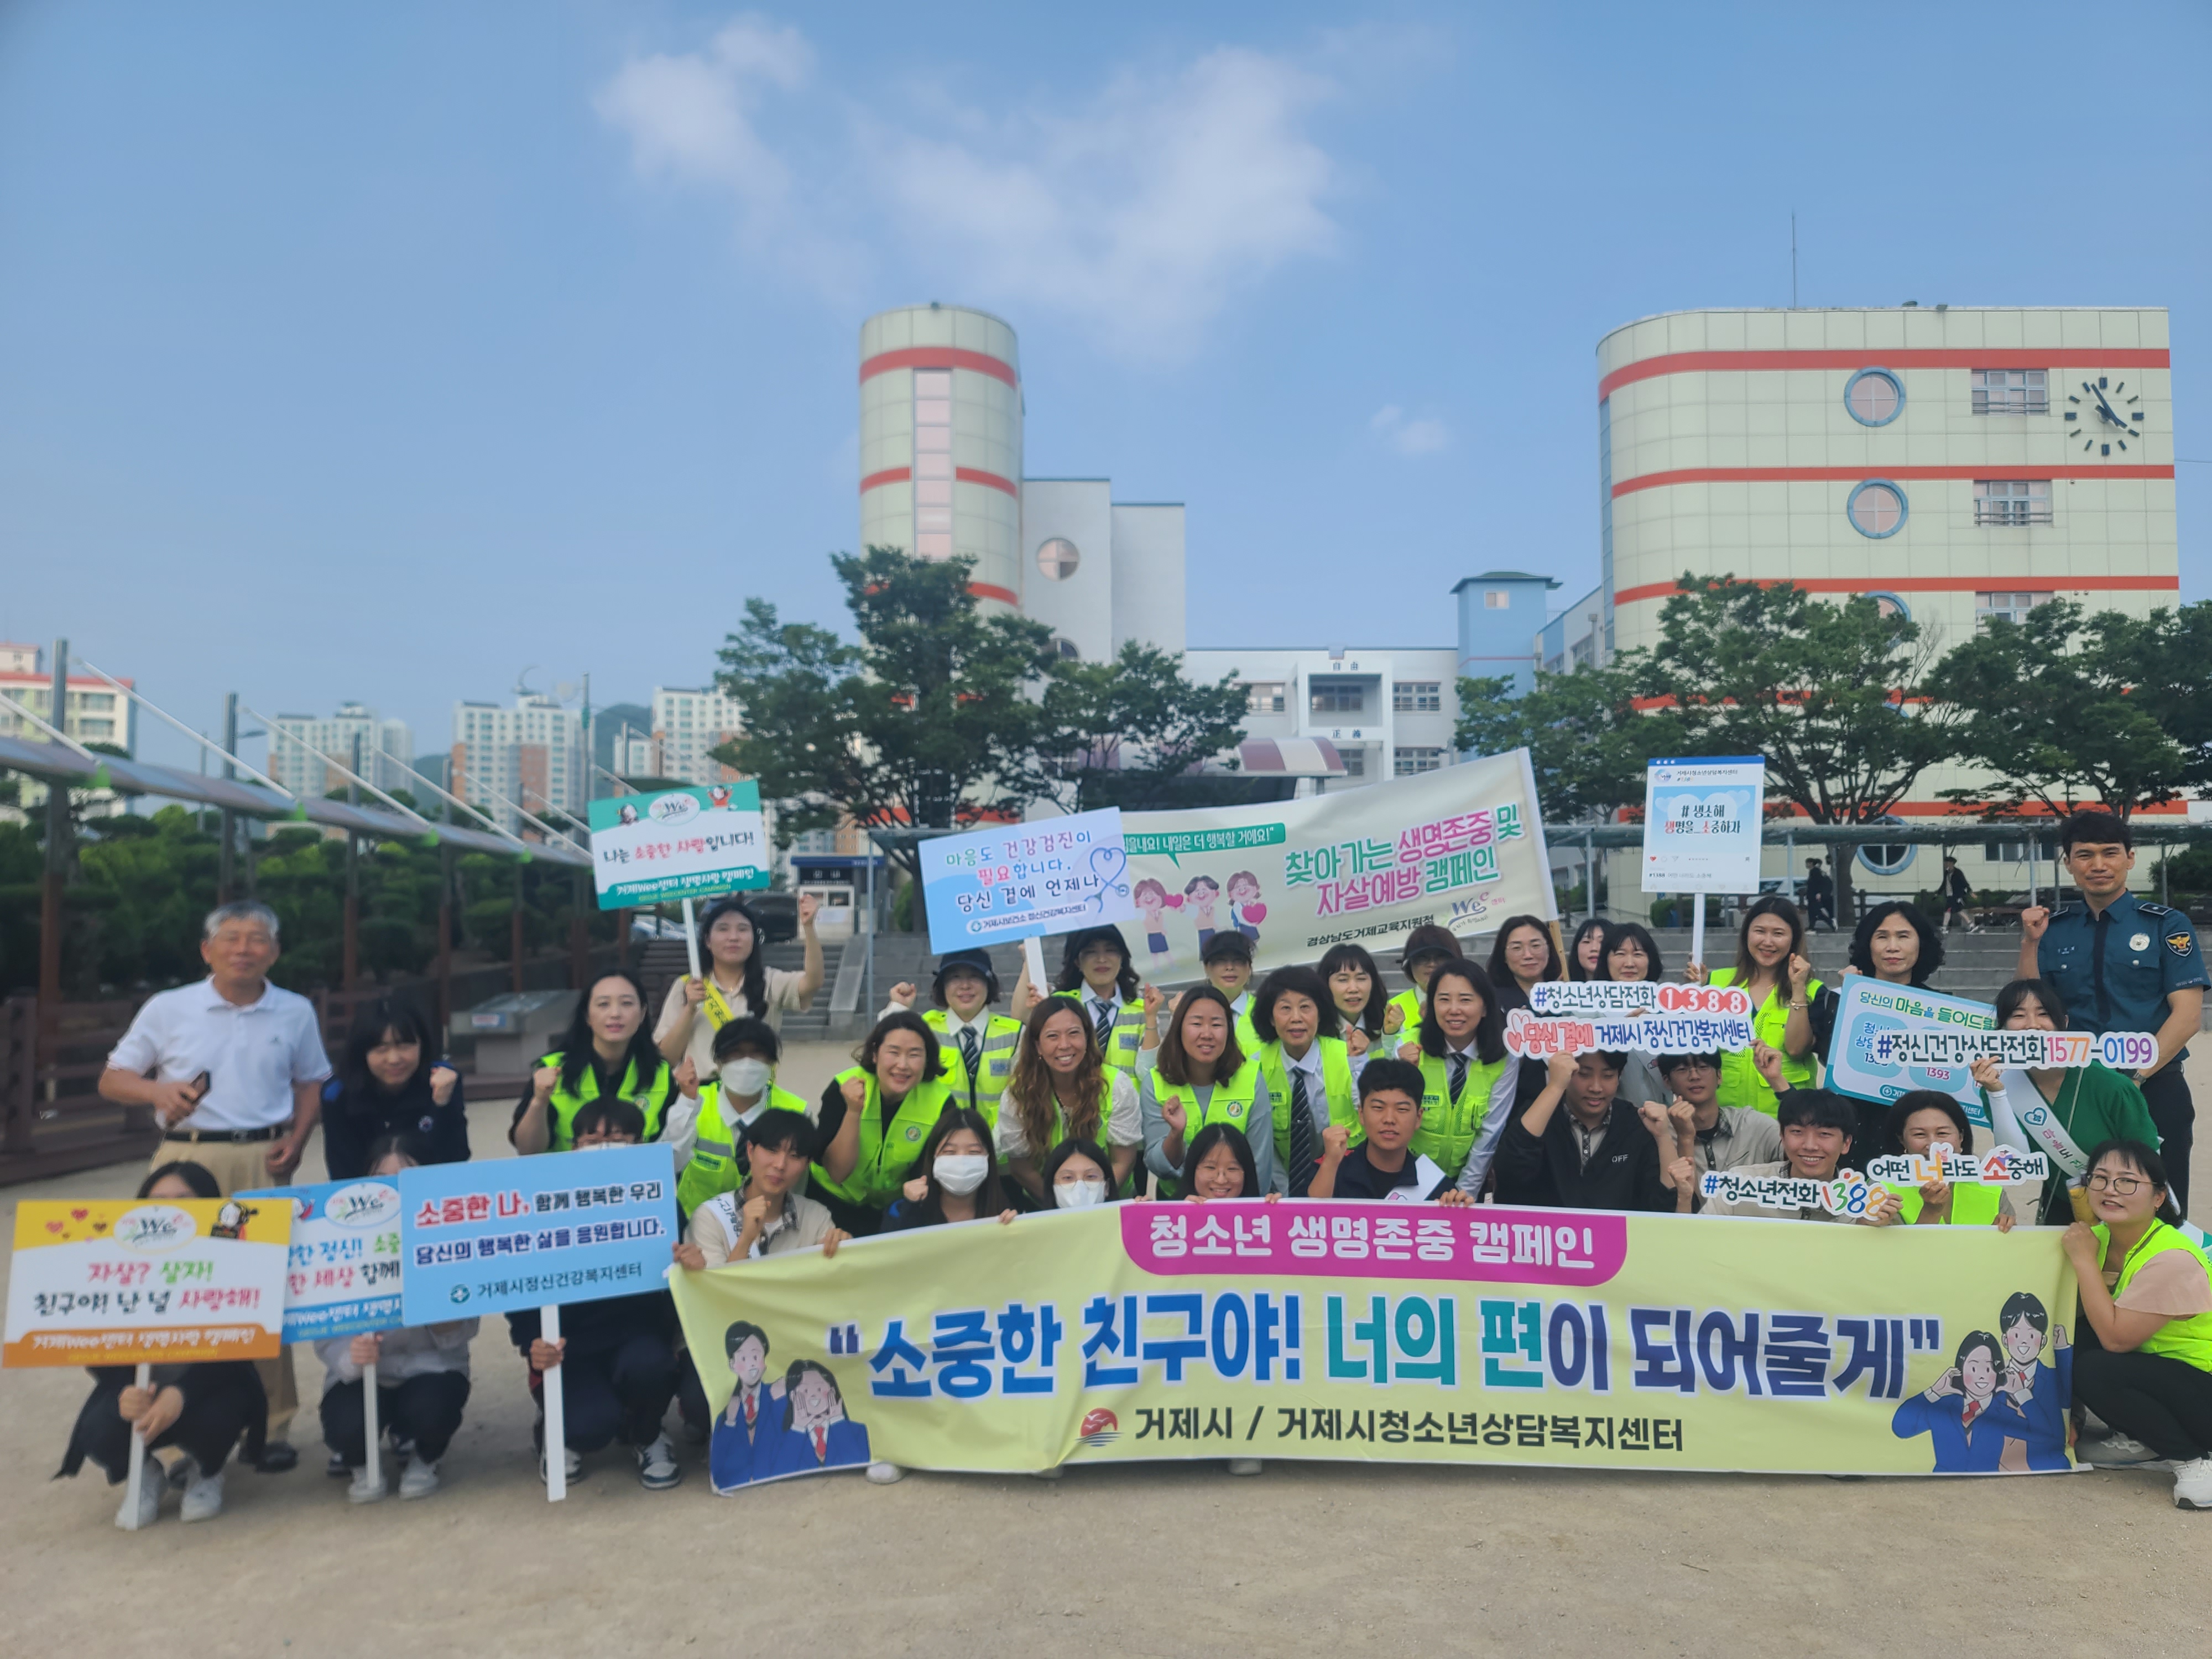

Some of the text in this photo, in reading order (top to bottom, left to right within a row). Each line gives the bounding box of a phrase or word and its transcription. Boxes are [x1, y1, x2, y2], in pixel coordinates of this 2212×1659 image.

[603, 848, 630, 864] 나는
[946, 831, 1092, 867] 마음도 건강검진이
[1163, 836, 1192, 852] 내일은
[1194, 834, 1204, 850] 더
[1207, 831, 1235, 848] 행복할
[1285, 804, 1521, 885] 찾아가는 생명존중 및
[977, 859, 1071, 886] 필요합니다.
[1317, 846, 1498, 915] 자살예방 캠페인
[958, 874, 1099, 913] 당신 곁에 언제나
[1860, 992, 1893, 1009] 당신의
[1896, 997, 1934, 1019] 마음을
[1523, 1019, 1751, 1053] 당신 곁에 거제시 정신건강복지센터
[1926, 1067, 1950, 1080] 1393
[1611, 1154, 1628, 1163] OFF
[1872, 1151, 2044, 1183] 어떤 너라도 소중해
[416, 1181, 661, 1228] 소중한 나, 함께 행복한 우리
[320, 1238, 362, 1261] 정신!
[416, 1218, 666, 1266] 당신의 행복한 삶을 응원합니다.
[1151, 1214, 1594, 1269] 청소년 생명존중 캠페인
[315, 1266, 354, 1288] 세상
[478, 1262, 642, 1298] 거제시정신건강복지센터
[34, 1288, 260, 1316] 친구야! 난 널 사랑해!
[1082, 1292, 1300, 1389] 친구야!
[1327, 1295, 1455, 1385] 너의
[1480, 1299, 1609, 1391] 편이
[1135, 1406, 1233, 1441] 거제시
[1277, 1407, 1683, 1452] 거제시청소년상담복지센터
